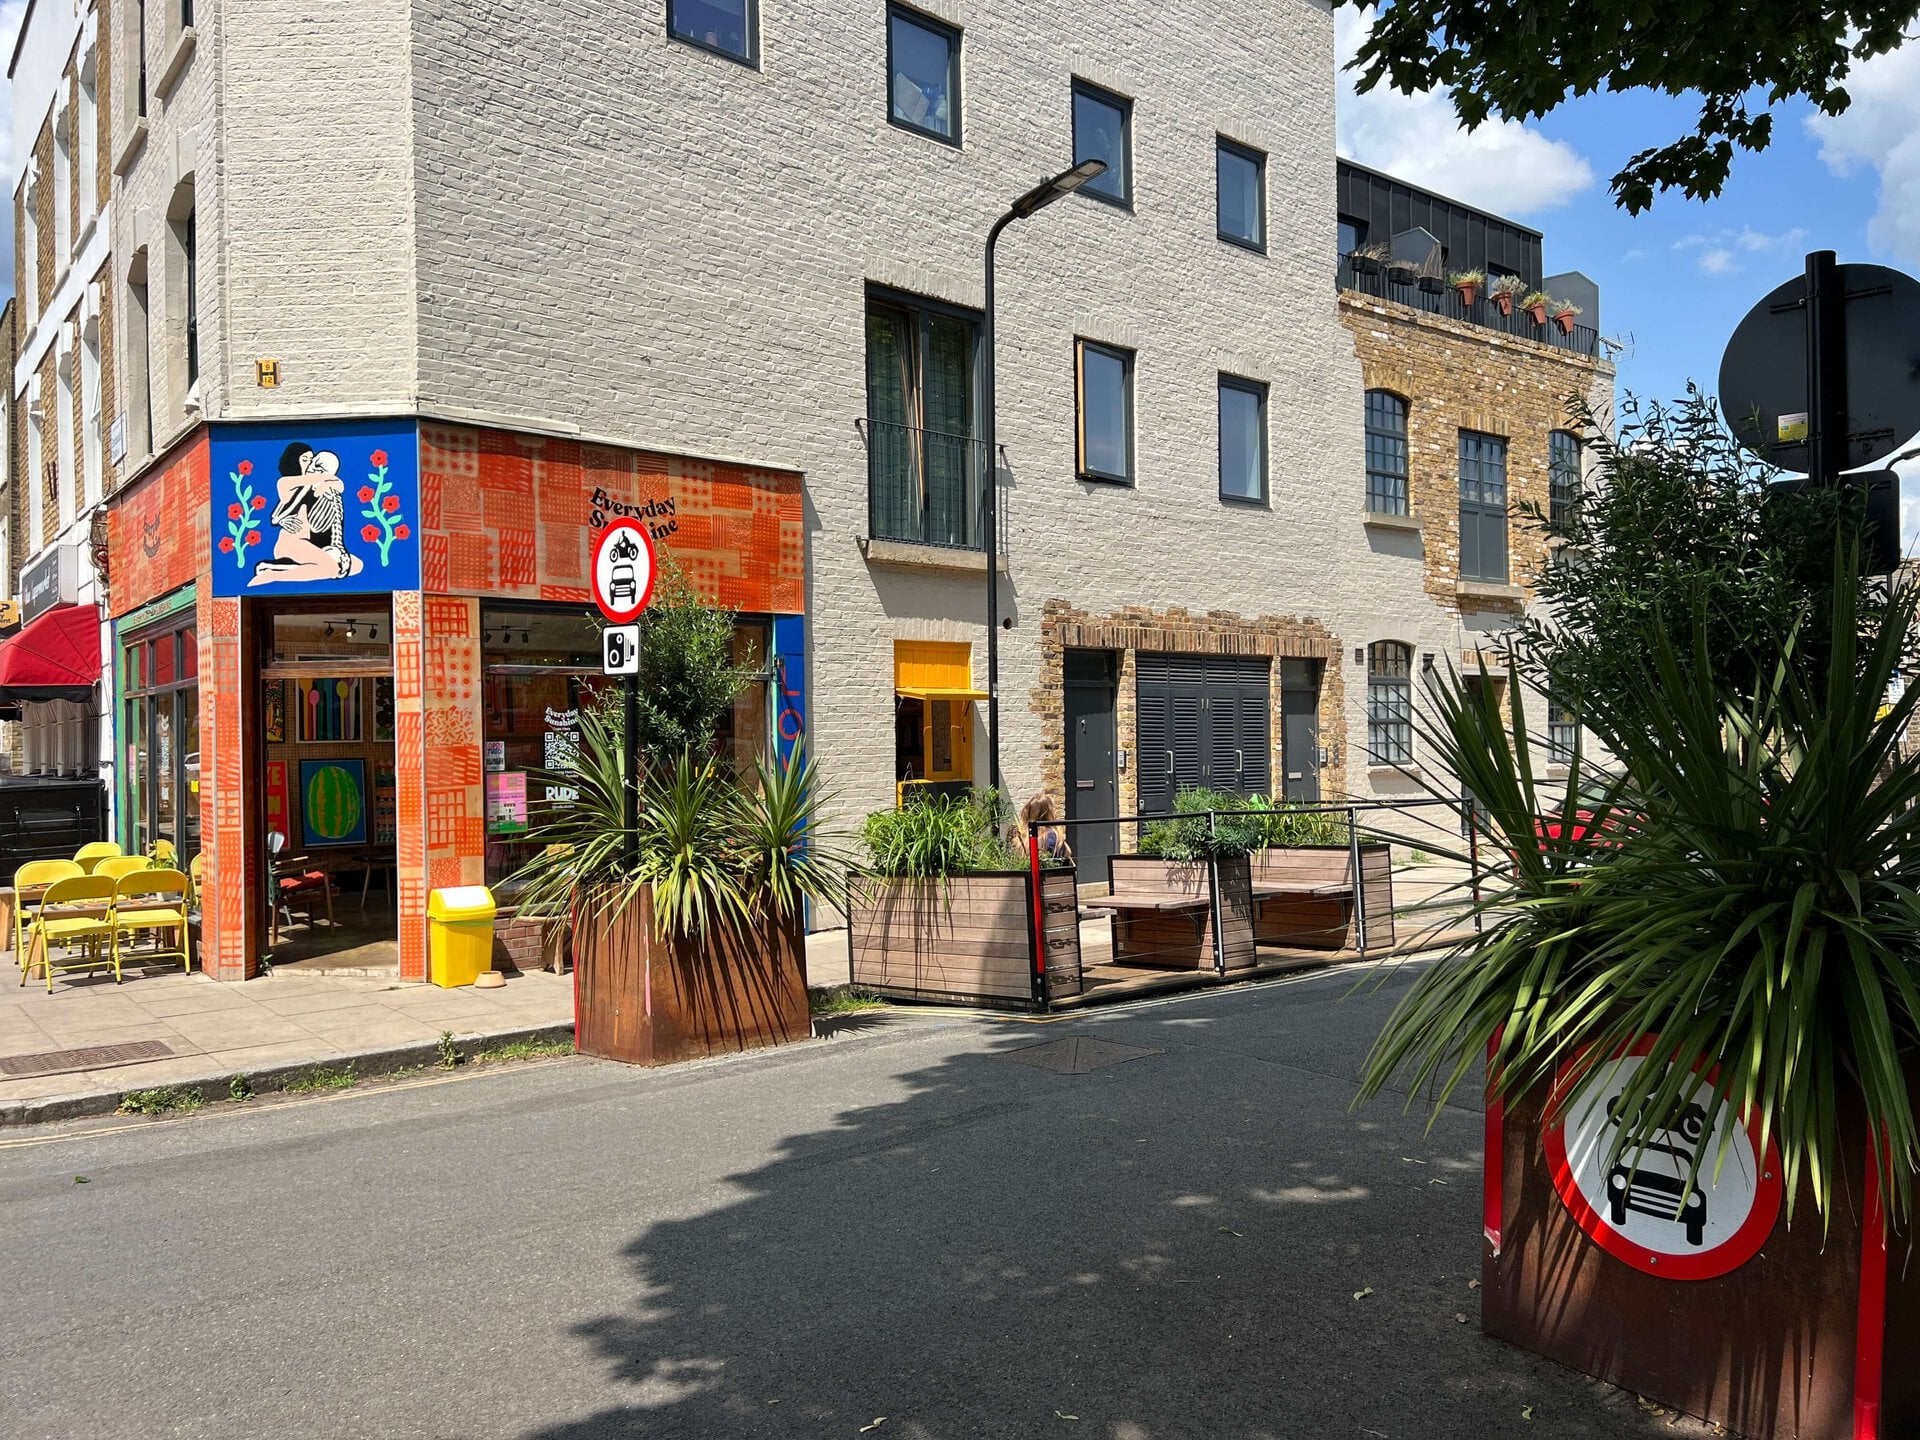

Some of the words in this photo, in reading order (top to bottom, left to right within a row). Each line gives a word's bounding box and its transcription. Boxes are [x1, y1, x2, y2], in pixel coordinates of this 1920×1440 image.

[264, 376, 273, 384] 12
[591, 487, 675, 520] Everyday
[589, 510, 678, 539] Sine
[544, 706, 578, 719] Everyday
[545, 786, 579, 801] RUDE
